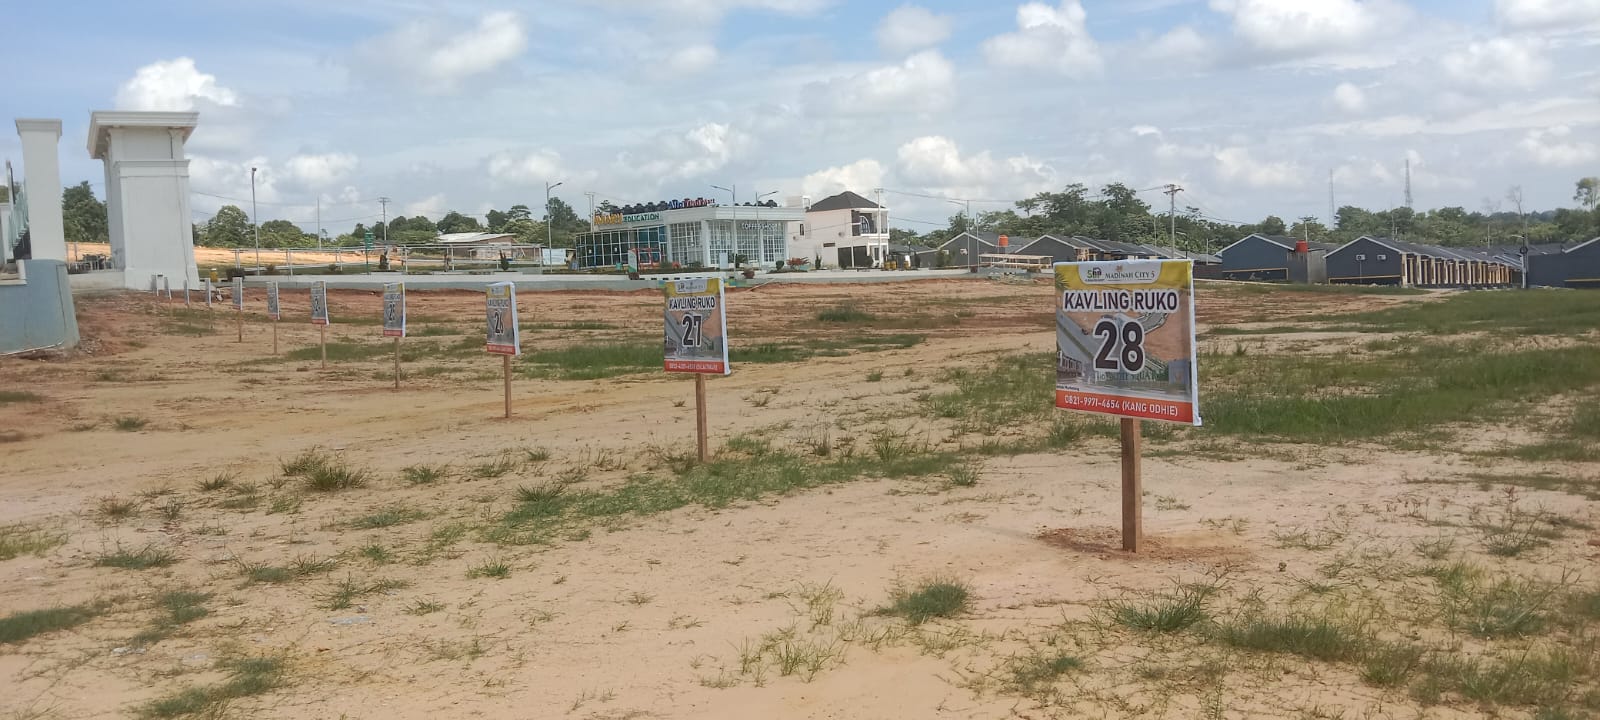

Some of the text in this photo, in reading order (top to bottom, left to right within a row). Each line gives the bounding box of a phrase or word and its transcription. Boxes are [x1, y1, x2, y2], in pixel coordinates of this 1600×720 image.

[1105, 271, 1133, 279] MADINAH
[1151, 270, 1155, 278] 5
[669, 296, 716, 309] KAVLING RUKO
[1064, 291, 1178, 311] KAVLING RUKO
[682, 315, 702, 346] 27
[1093, 320, 1144, 372] 28
[1064, 395, 1179, 417] 0821-9971-4654 (KANG ODHIE)
